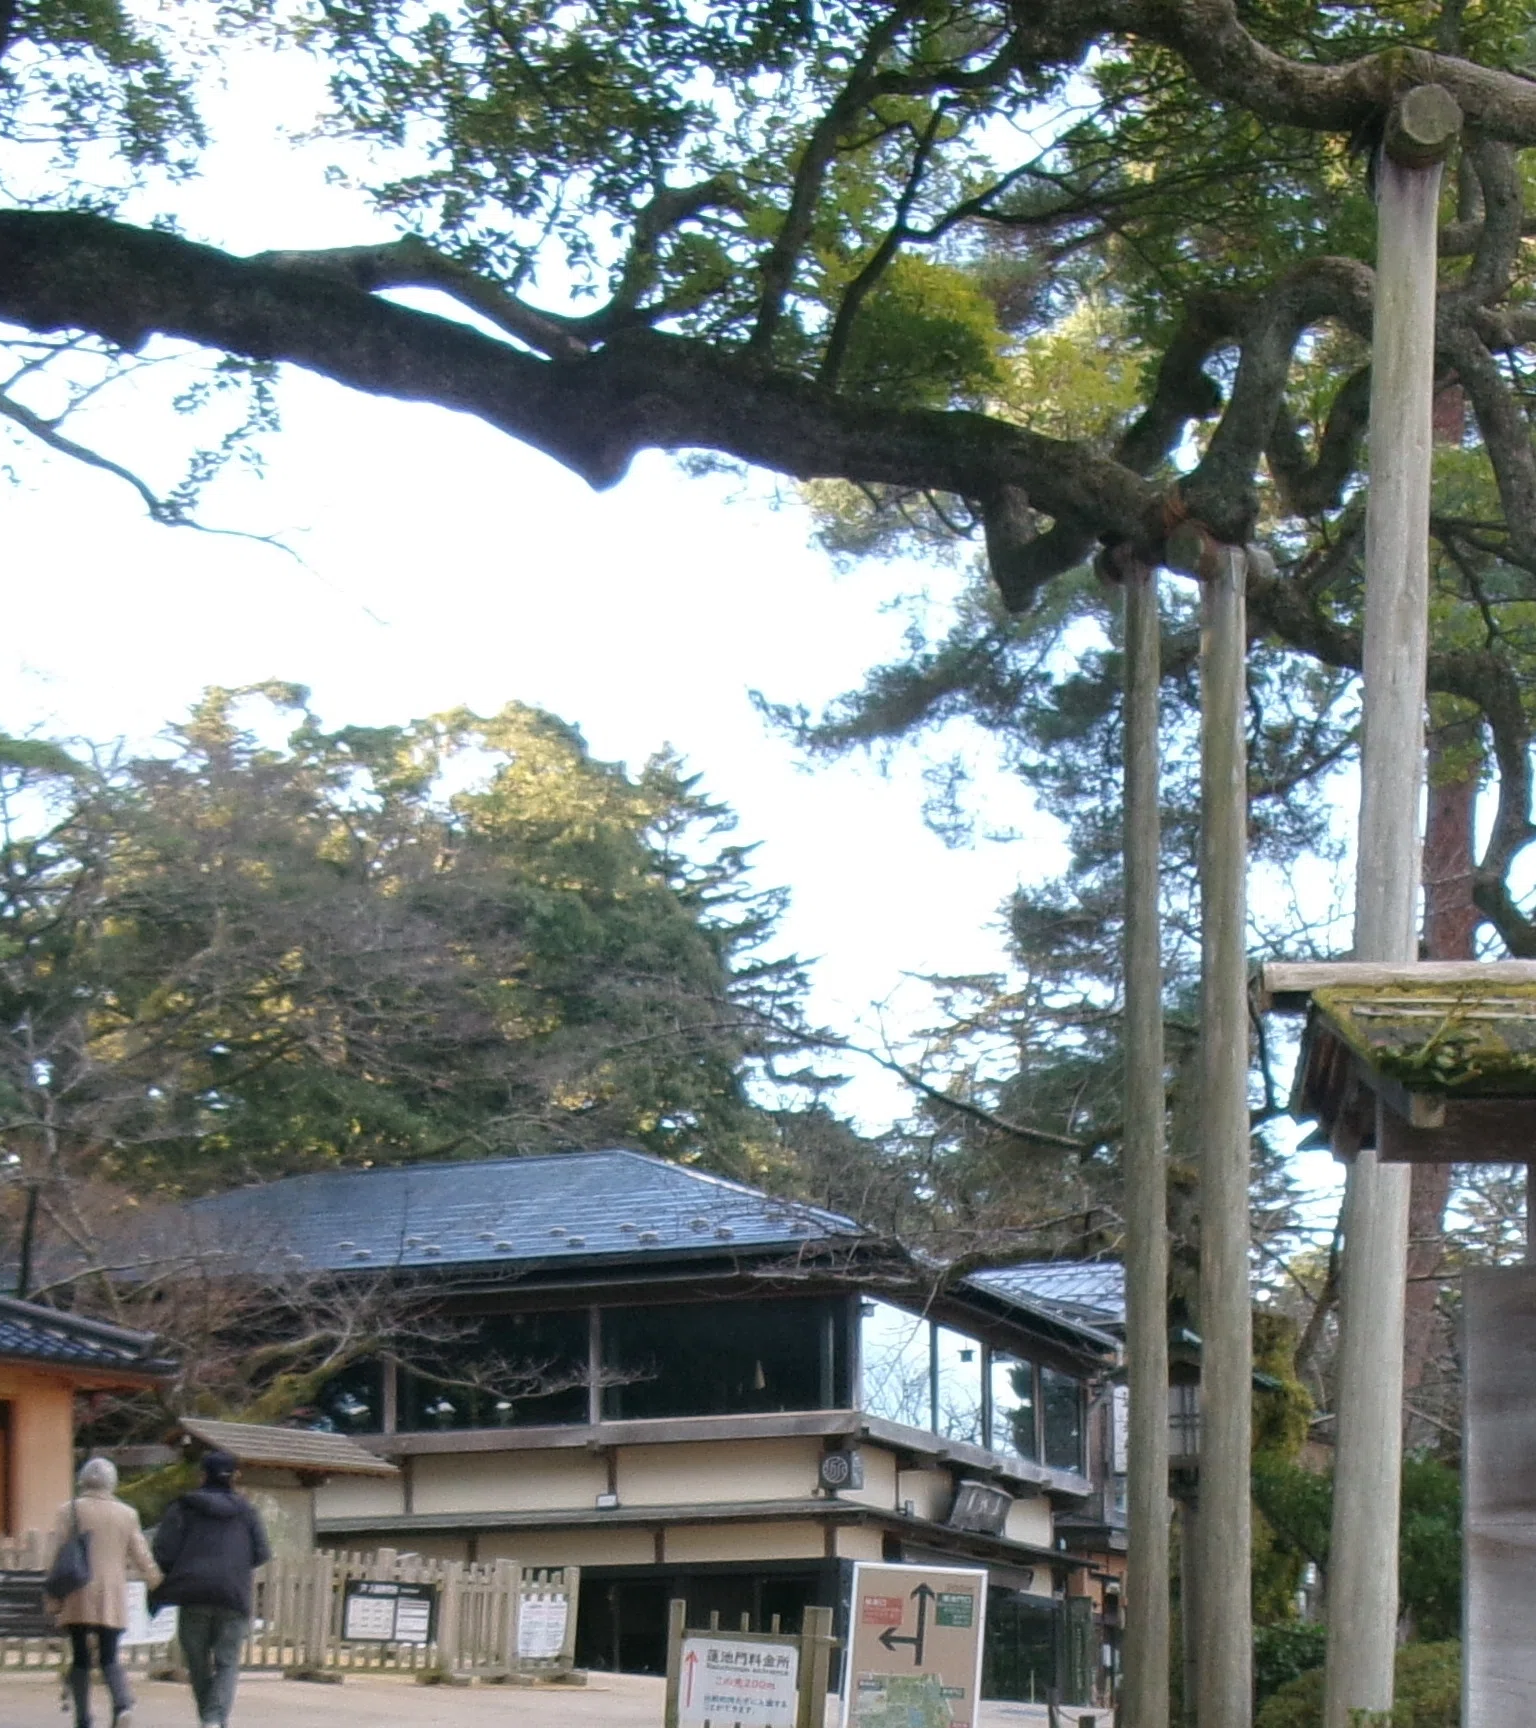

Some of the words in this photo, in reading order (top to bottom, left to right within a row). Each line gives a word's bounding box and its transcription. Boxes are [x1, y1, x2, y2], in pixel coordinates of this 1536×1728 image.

[707, 1649, 790, 1669] 蓮池門料金所
